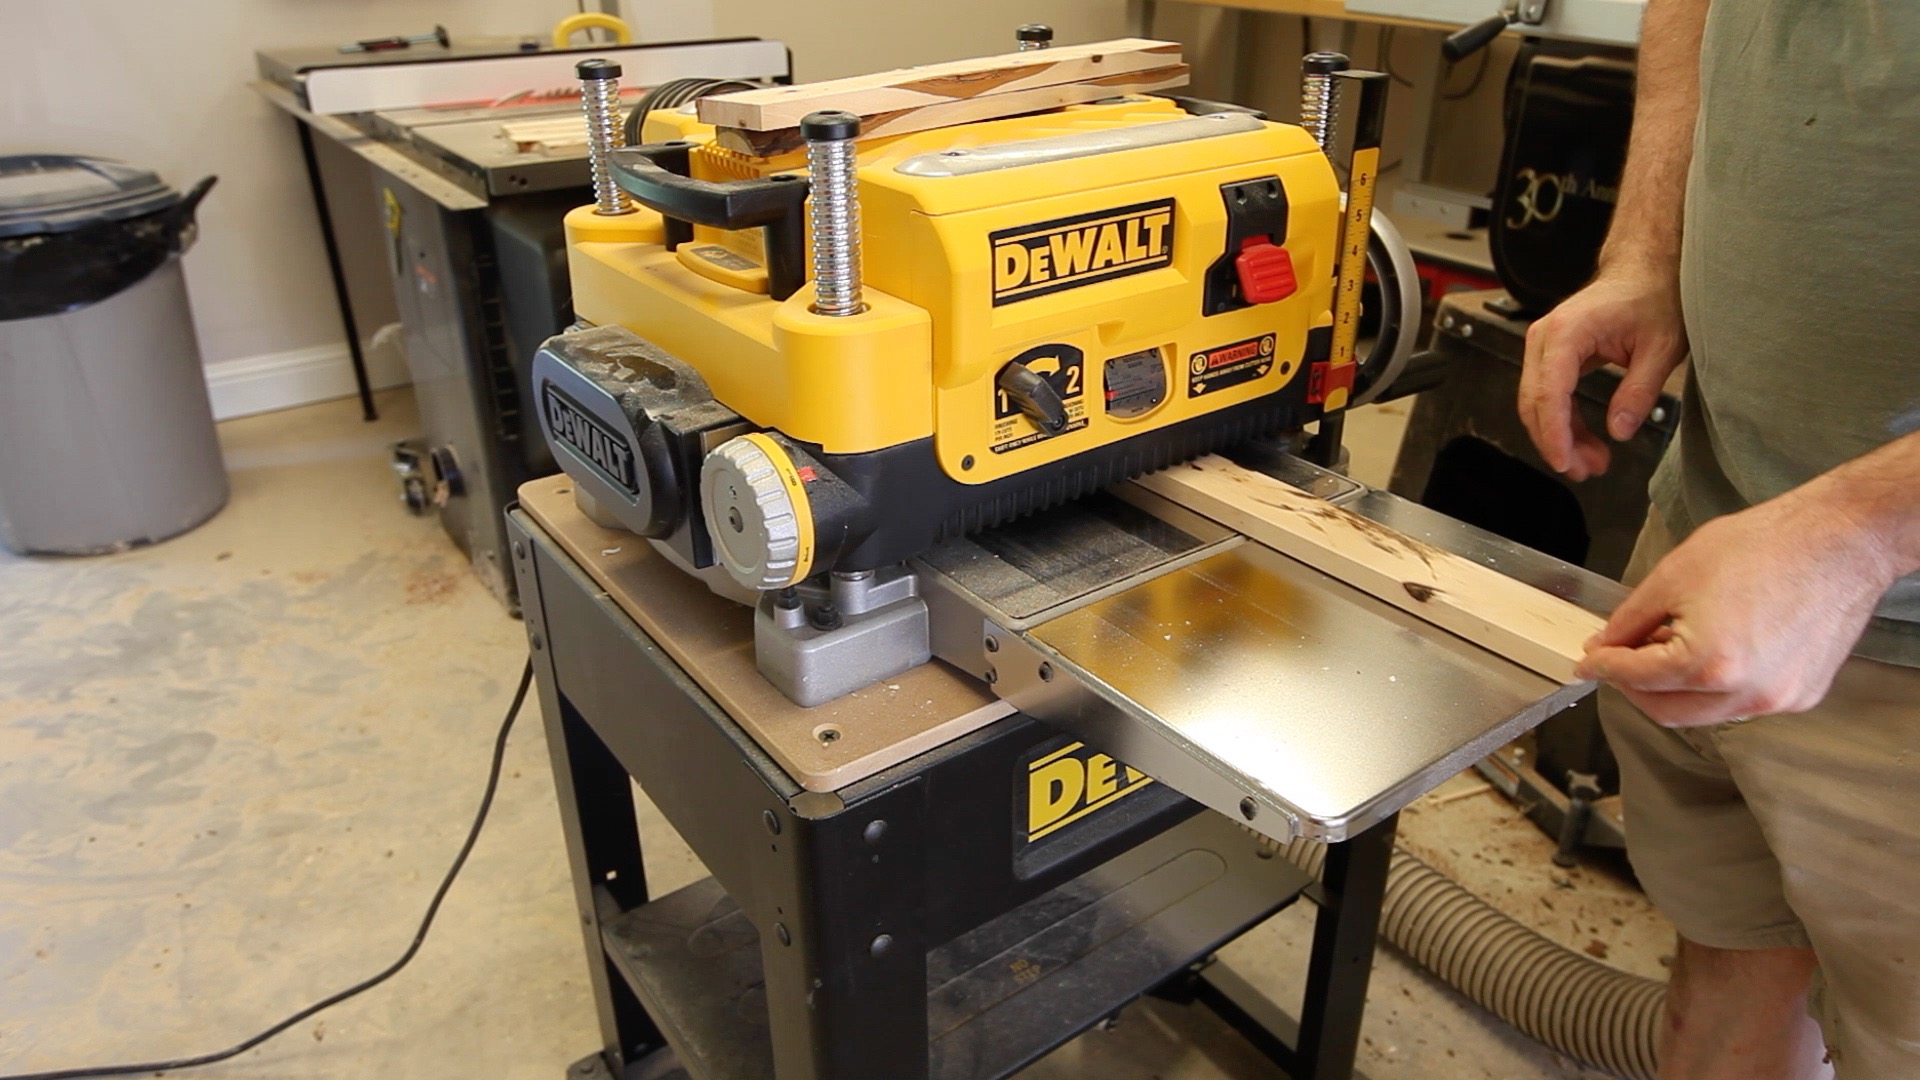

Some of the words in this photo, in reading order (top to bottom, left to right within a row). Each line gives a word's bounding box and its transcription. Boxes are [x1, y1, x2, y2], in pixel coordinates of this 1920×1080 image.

[1360, 172, 1367, 186] 6
[1355, 208, 1362, 222] 5
[1351, 244, 1358, 256] 4
[1347, 279, 1354, 291] 3
[1343, 311, 1350, 324] 2
[1219, 343, 1257, 363] WARNING
[1340, 346, 1345, 357] 1
[1066, 365, 1080, 394] 2
[998, 388, 1008, 413] 1
